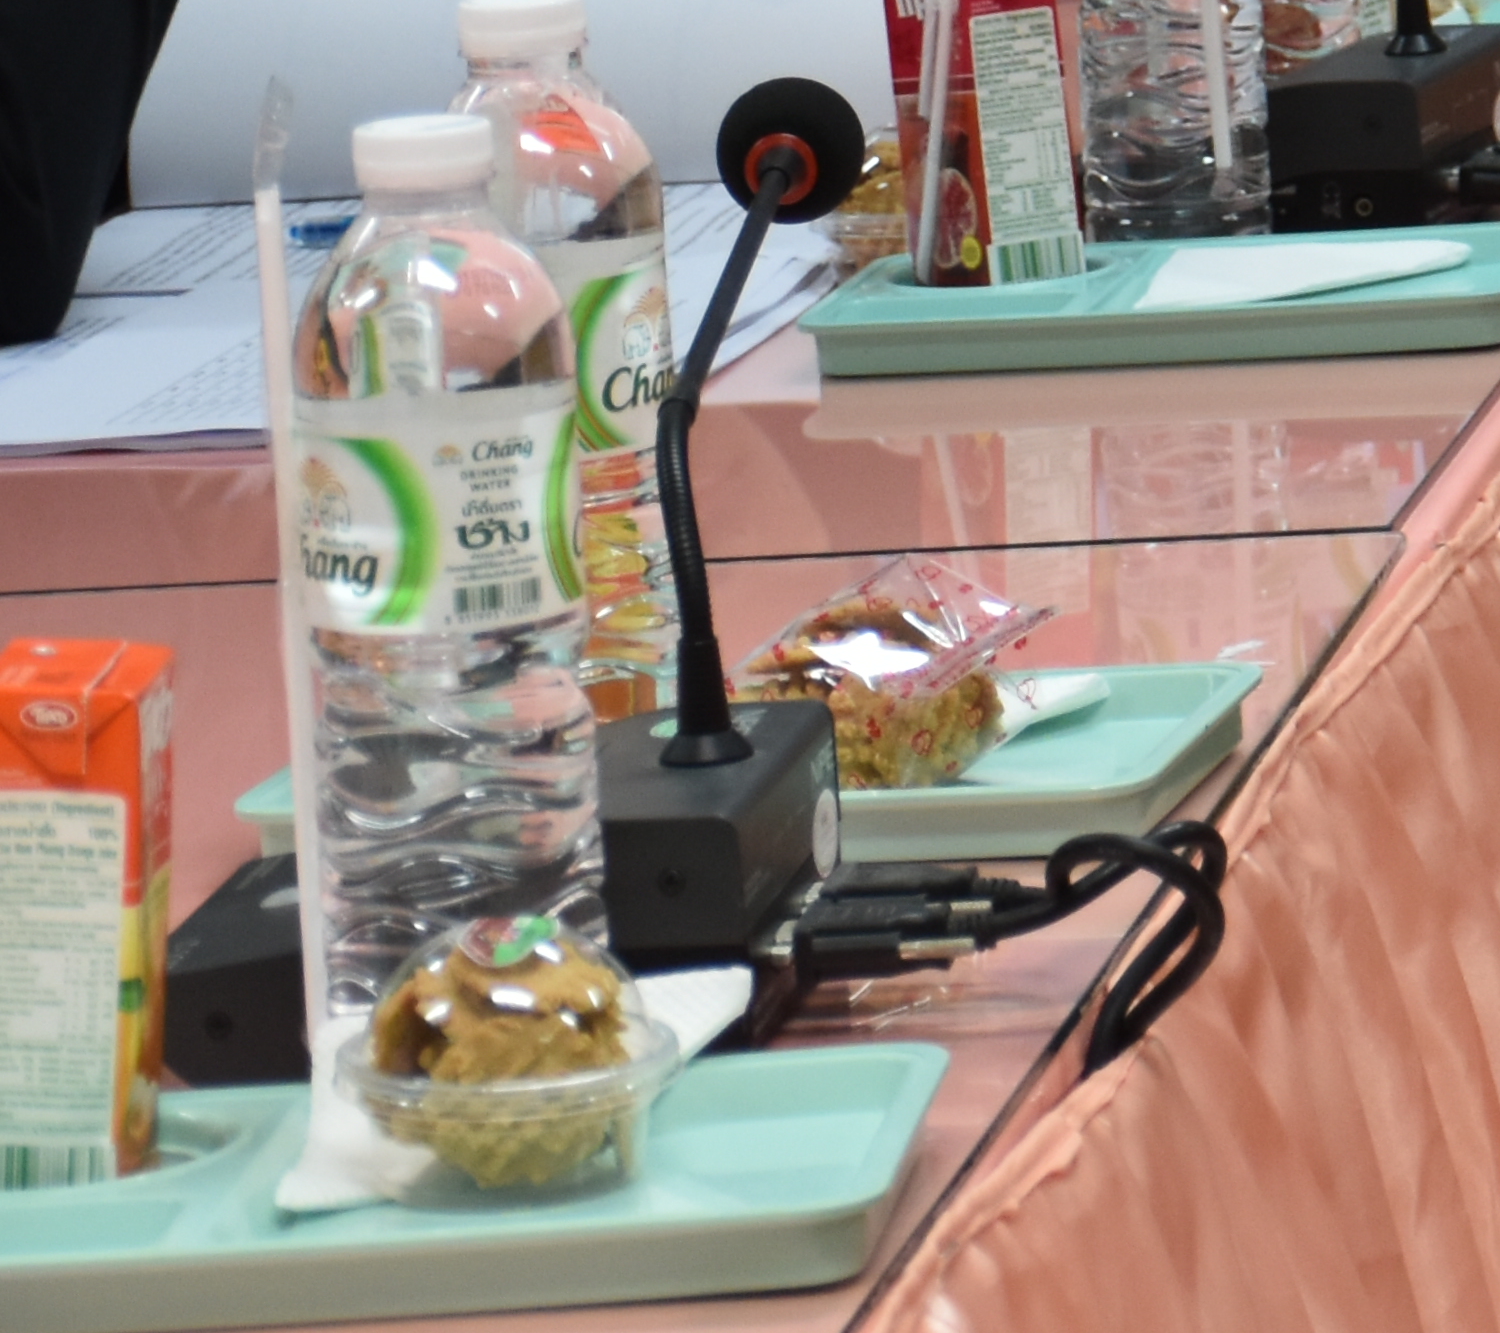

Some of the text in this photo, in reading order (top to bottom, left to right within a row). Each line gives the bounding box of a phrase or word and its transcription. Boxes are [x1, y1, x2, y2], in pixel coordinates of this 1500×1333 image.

[601, 363, 673, 413] Cha
[472, 435, 534, 465] Chang
[460, 464, 519, 482] DRINKING
[470, 478, 511, 494] WATER
[300, 531, 379, 598] hang
